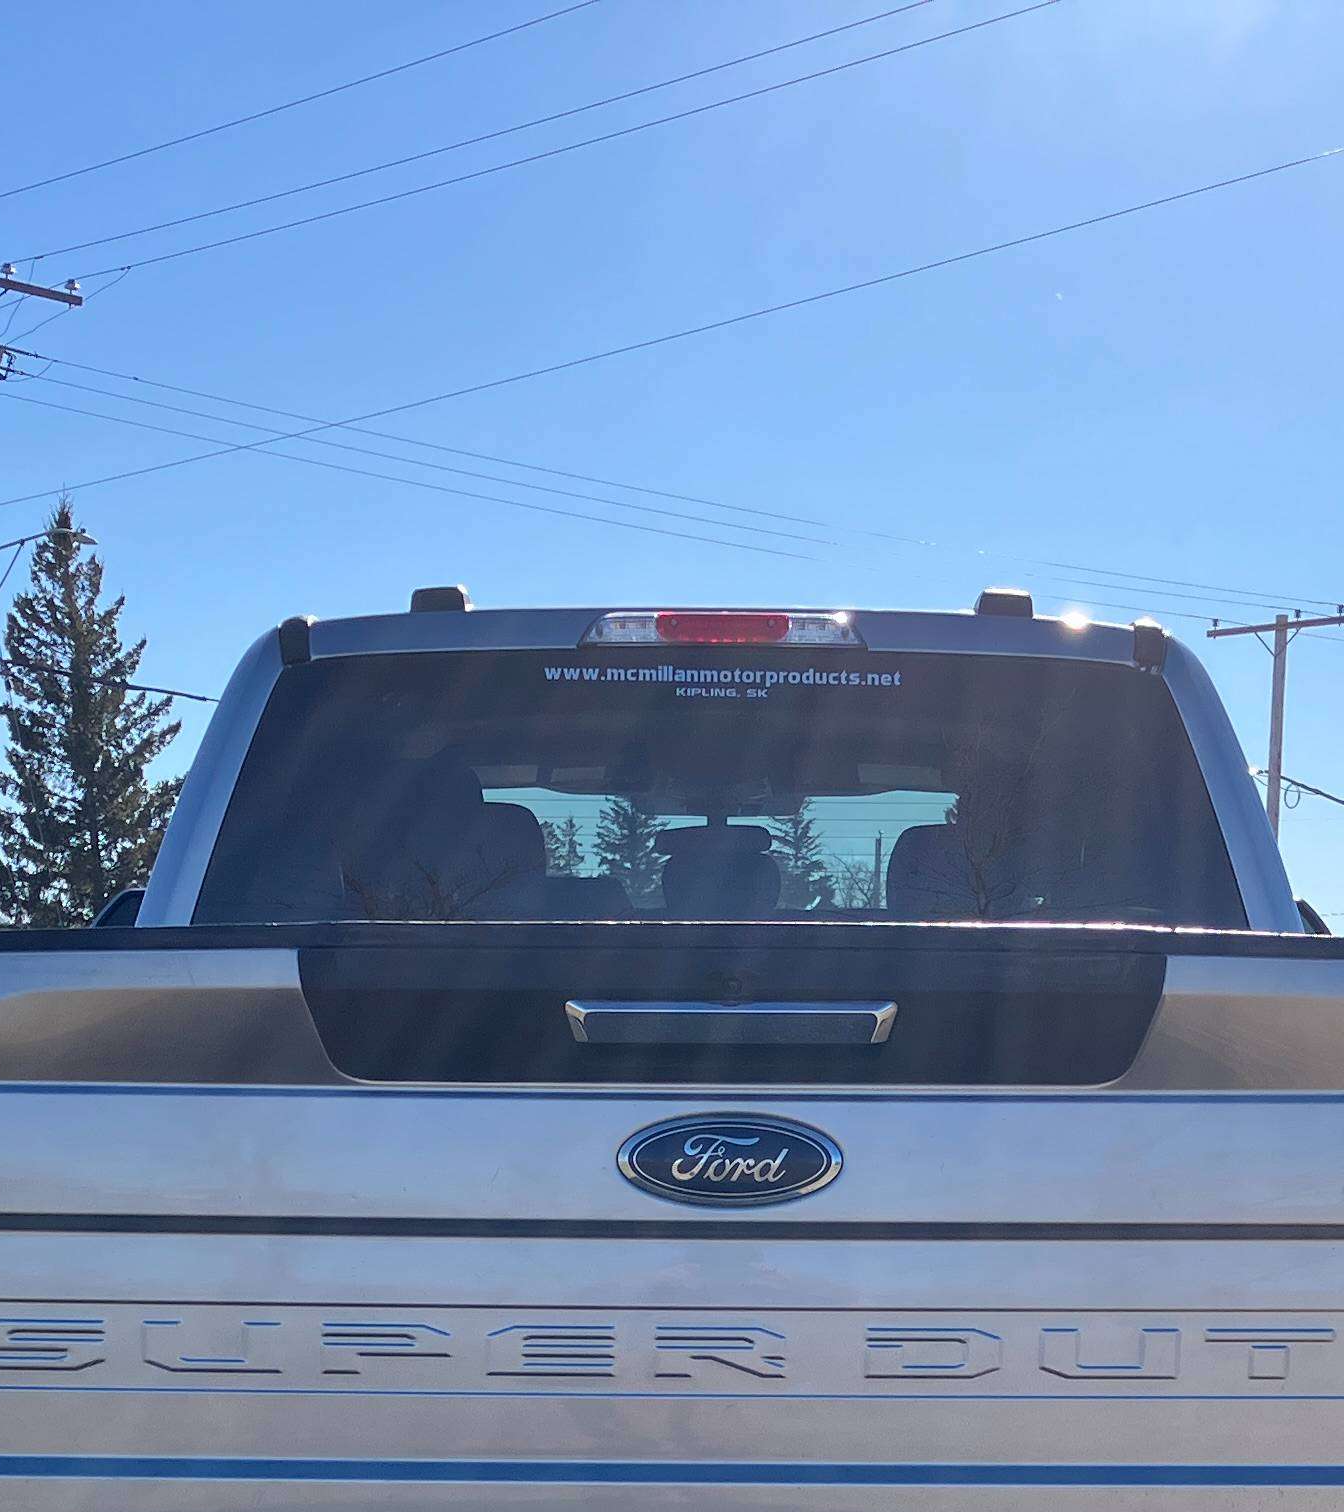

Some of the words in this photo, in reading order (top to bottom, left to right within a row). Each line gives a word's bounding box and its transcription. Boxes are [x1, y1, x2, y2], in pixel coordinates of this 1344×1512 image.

[544, 665, 902, 687] www.mcmillanmotorproducts.net
[746, 688, 769, 698] SK
[671, 1134, 790, 1183] Ford
